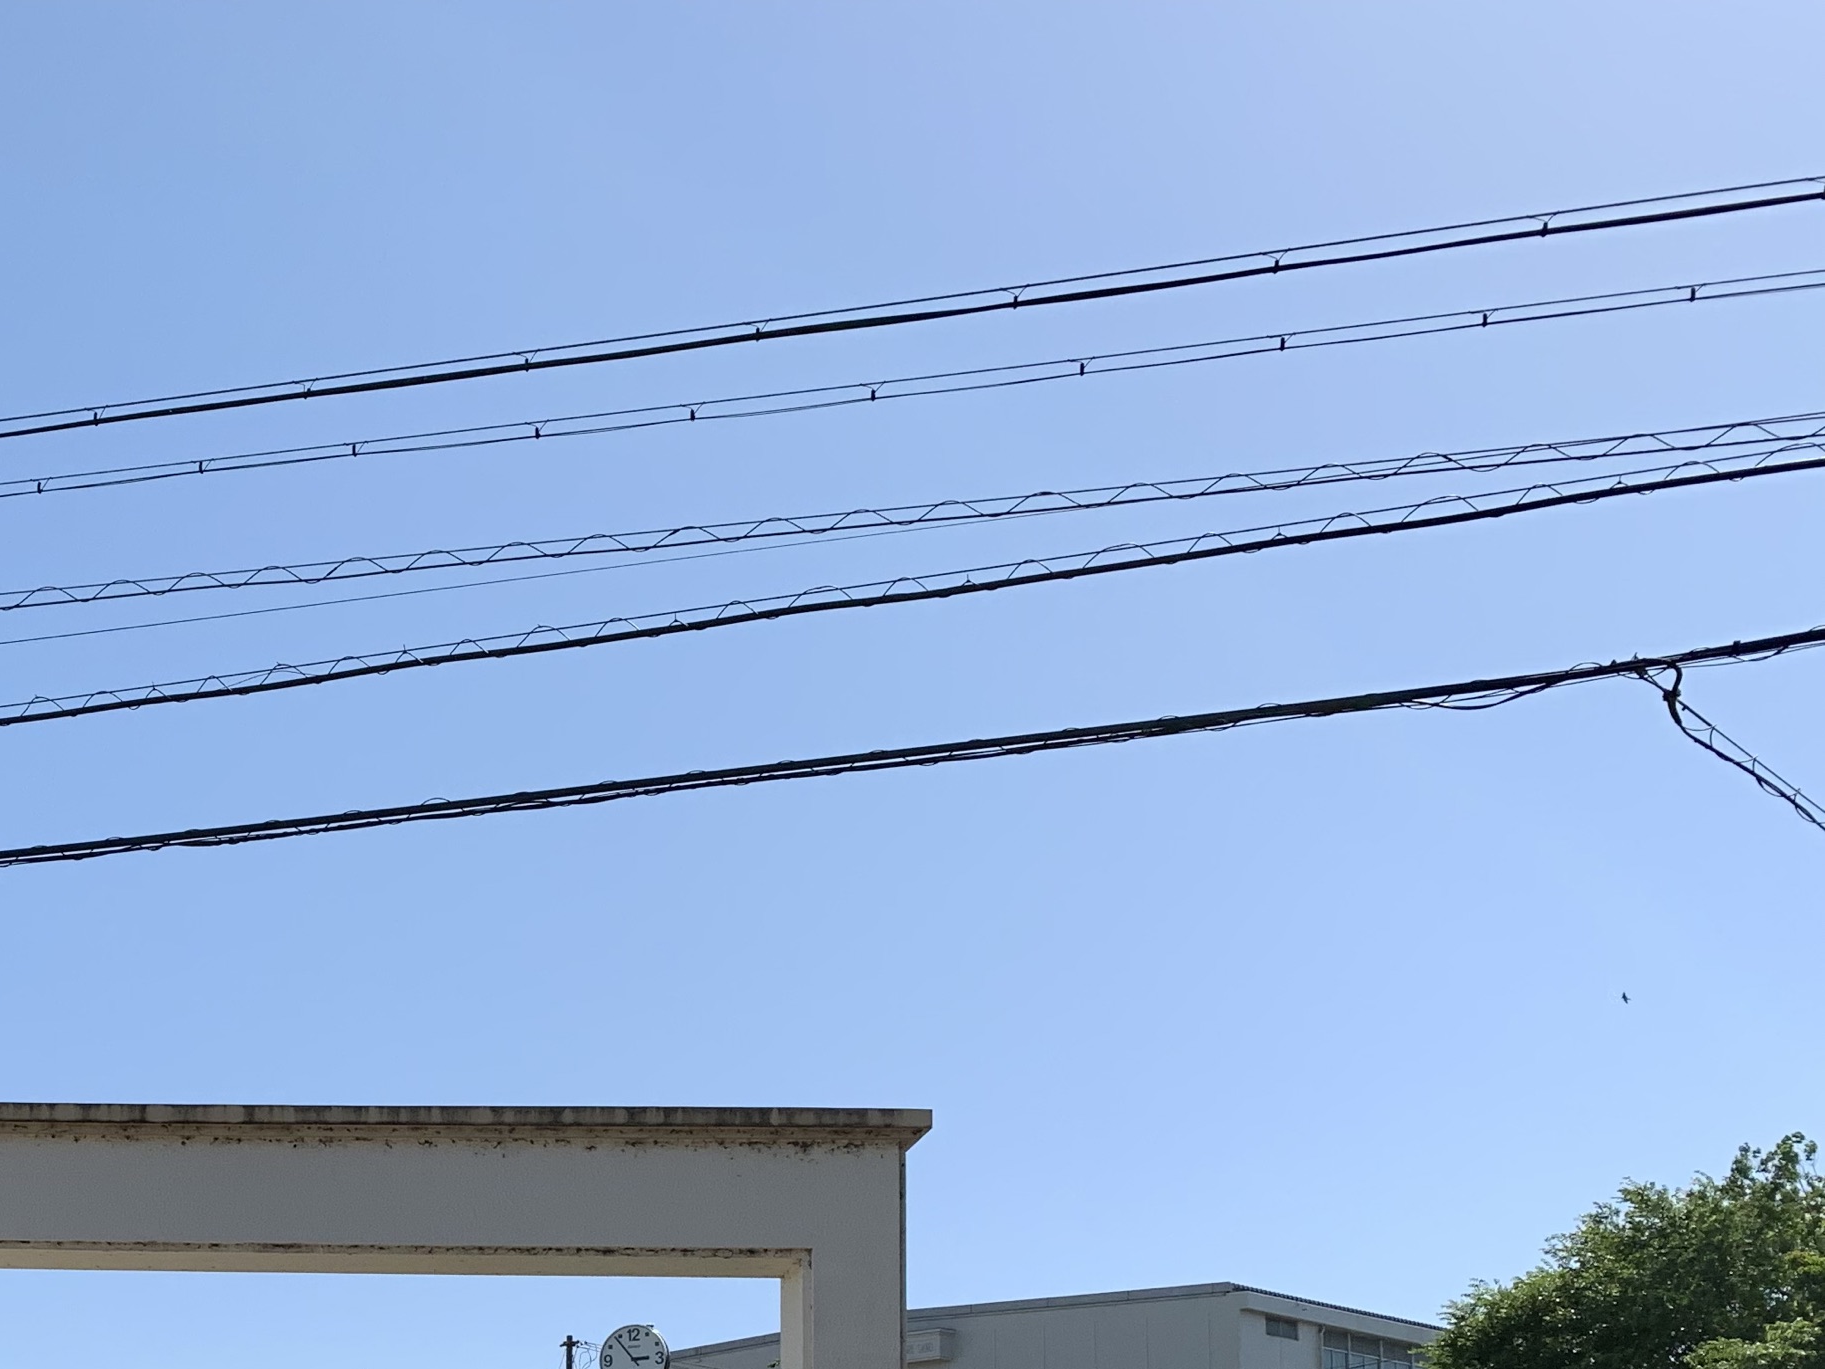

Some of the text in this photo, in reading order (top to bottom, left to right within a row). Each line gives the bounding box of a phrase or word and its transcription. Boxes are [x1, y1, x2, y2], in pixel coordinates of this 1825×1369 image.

[627, 1328, 640, 1341] 12
[604, 1354, 613, 1367] 9
[655, 1351, 664, 1364] 3
